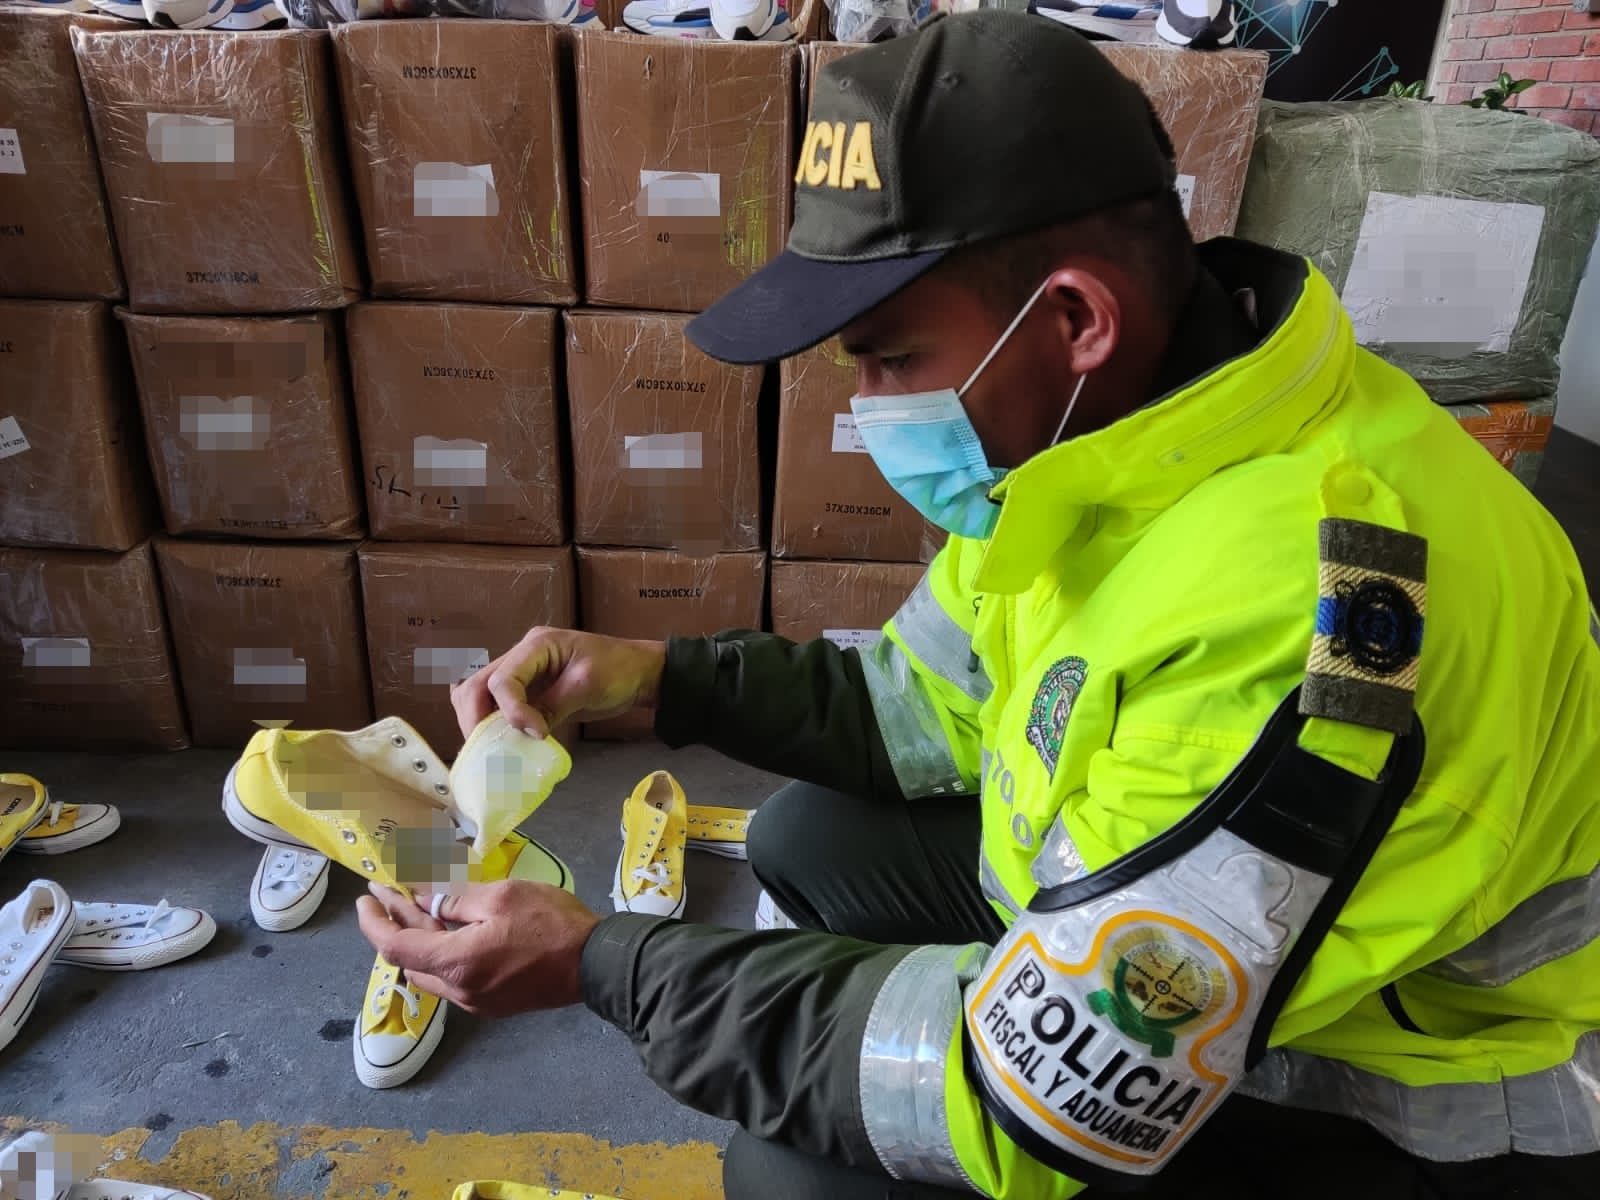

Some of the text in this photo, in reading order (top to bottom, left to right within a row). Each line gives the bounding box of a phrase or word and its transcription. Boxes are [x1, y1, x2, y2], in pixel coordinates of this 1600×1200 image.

[402, 64, 478, 79] 37X30X36CM
[636, 377, 706, 393] 37X30X36CM
[824, 502, 892, 517] 37X30X36CM
[1005, 958, 1202, 1125] POLICIA
[984, 1001, 1171, 1153] FISCAL Y ADUANERA
